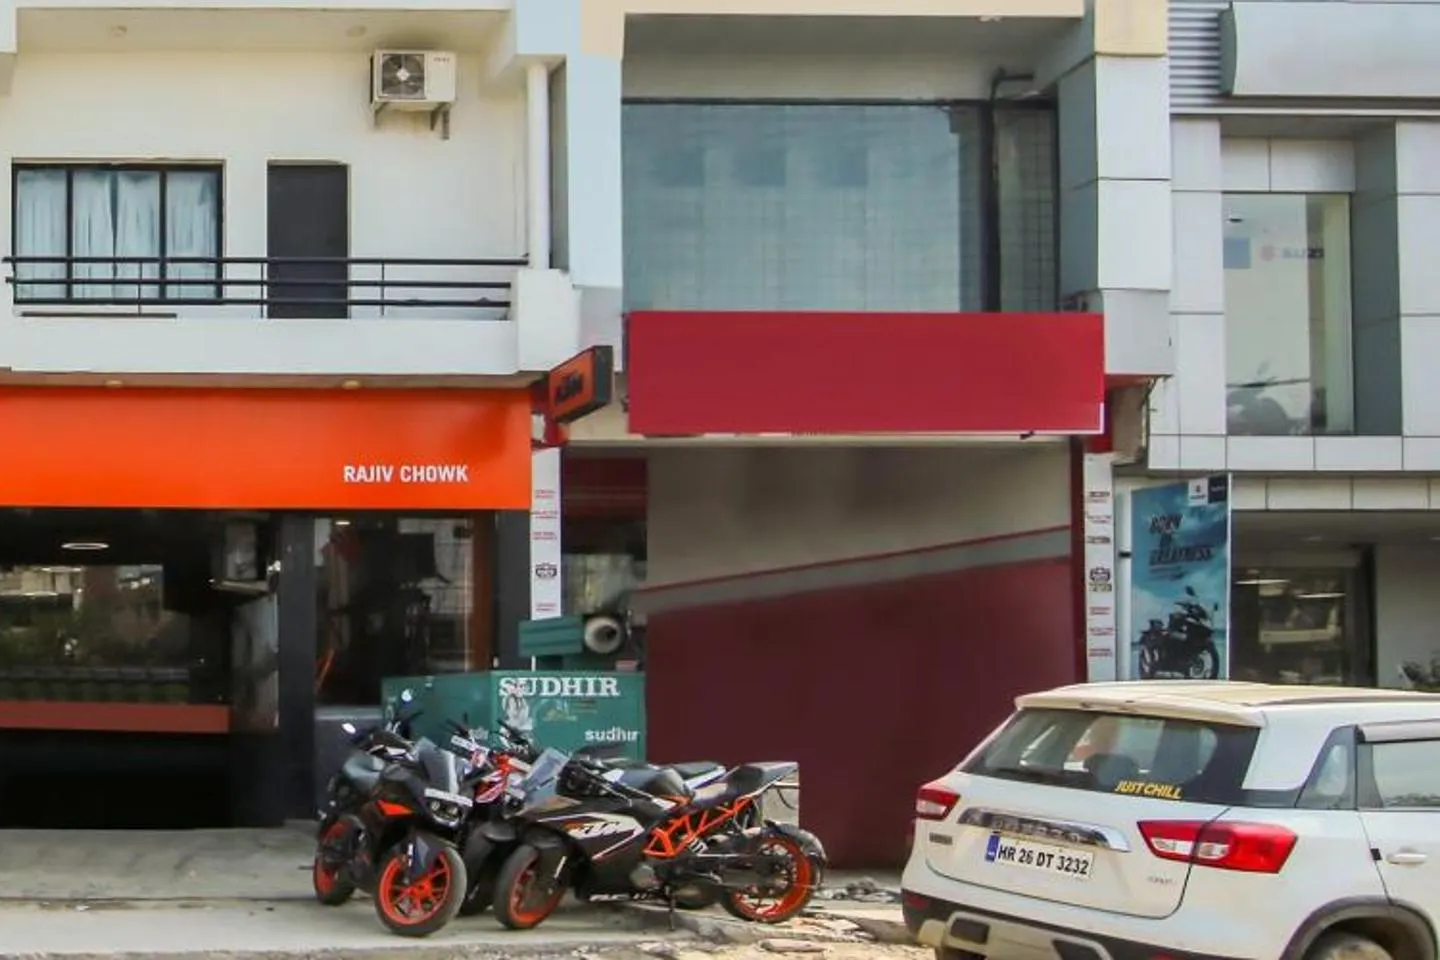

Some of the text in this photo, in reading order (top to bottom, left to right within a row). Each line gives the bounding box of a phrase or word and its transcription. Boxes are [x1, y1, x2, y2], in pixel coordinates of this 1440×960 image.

[343, 464, 469, 483] RAJIV CHOWK
[498, 677, 621, 698] SUDHIR
[584, 726, 640, 742] sudhir
[1115, 780, 1183, 800] JUST CHILL
[997, 843, 1090, 875] HR 26 DT 3232
